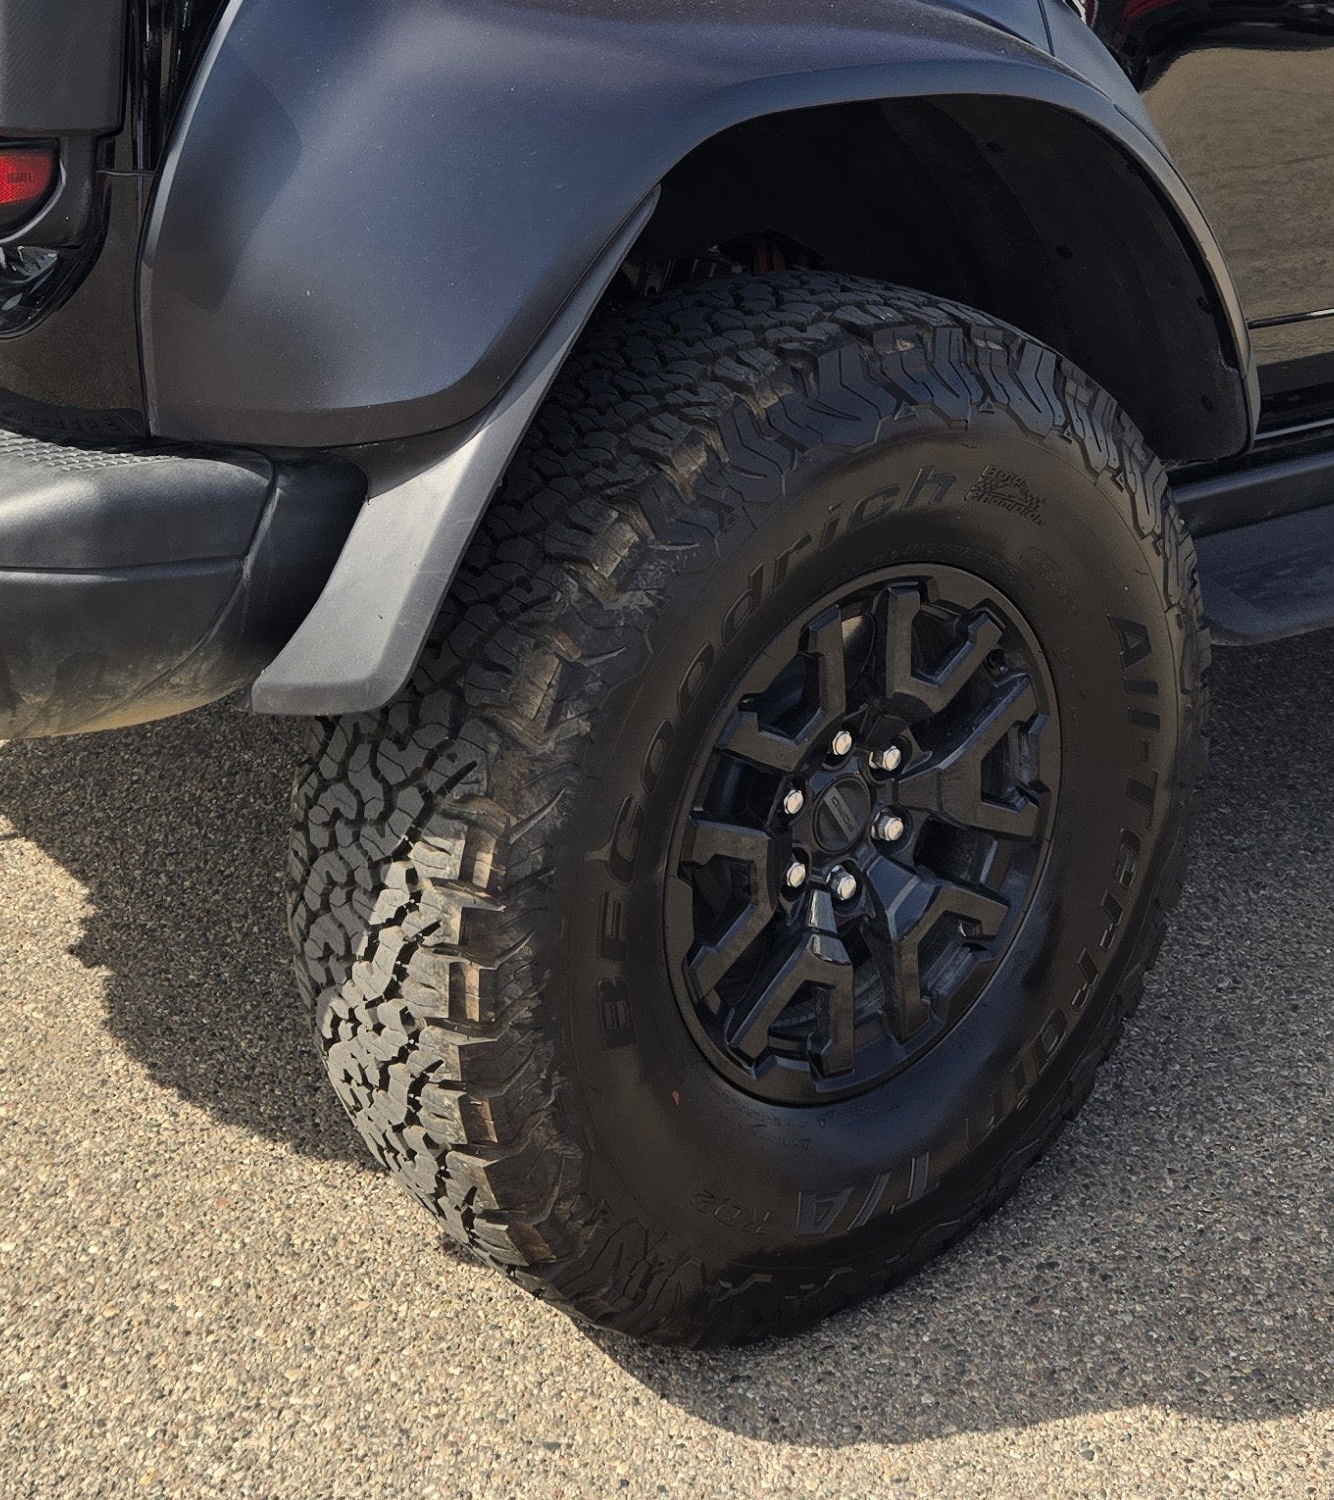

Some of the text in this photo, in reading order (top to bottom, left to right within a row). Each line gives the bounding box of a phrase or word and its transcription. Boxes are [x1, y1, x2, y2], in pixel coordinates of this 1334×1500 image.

[598, 464, 957, 1049] BFGoodrich
[794, 612, 1159, 1238] All-Terrain T/A
